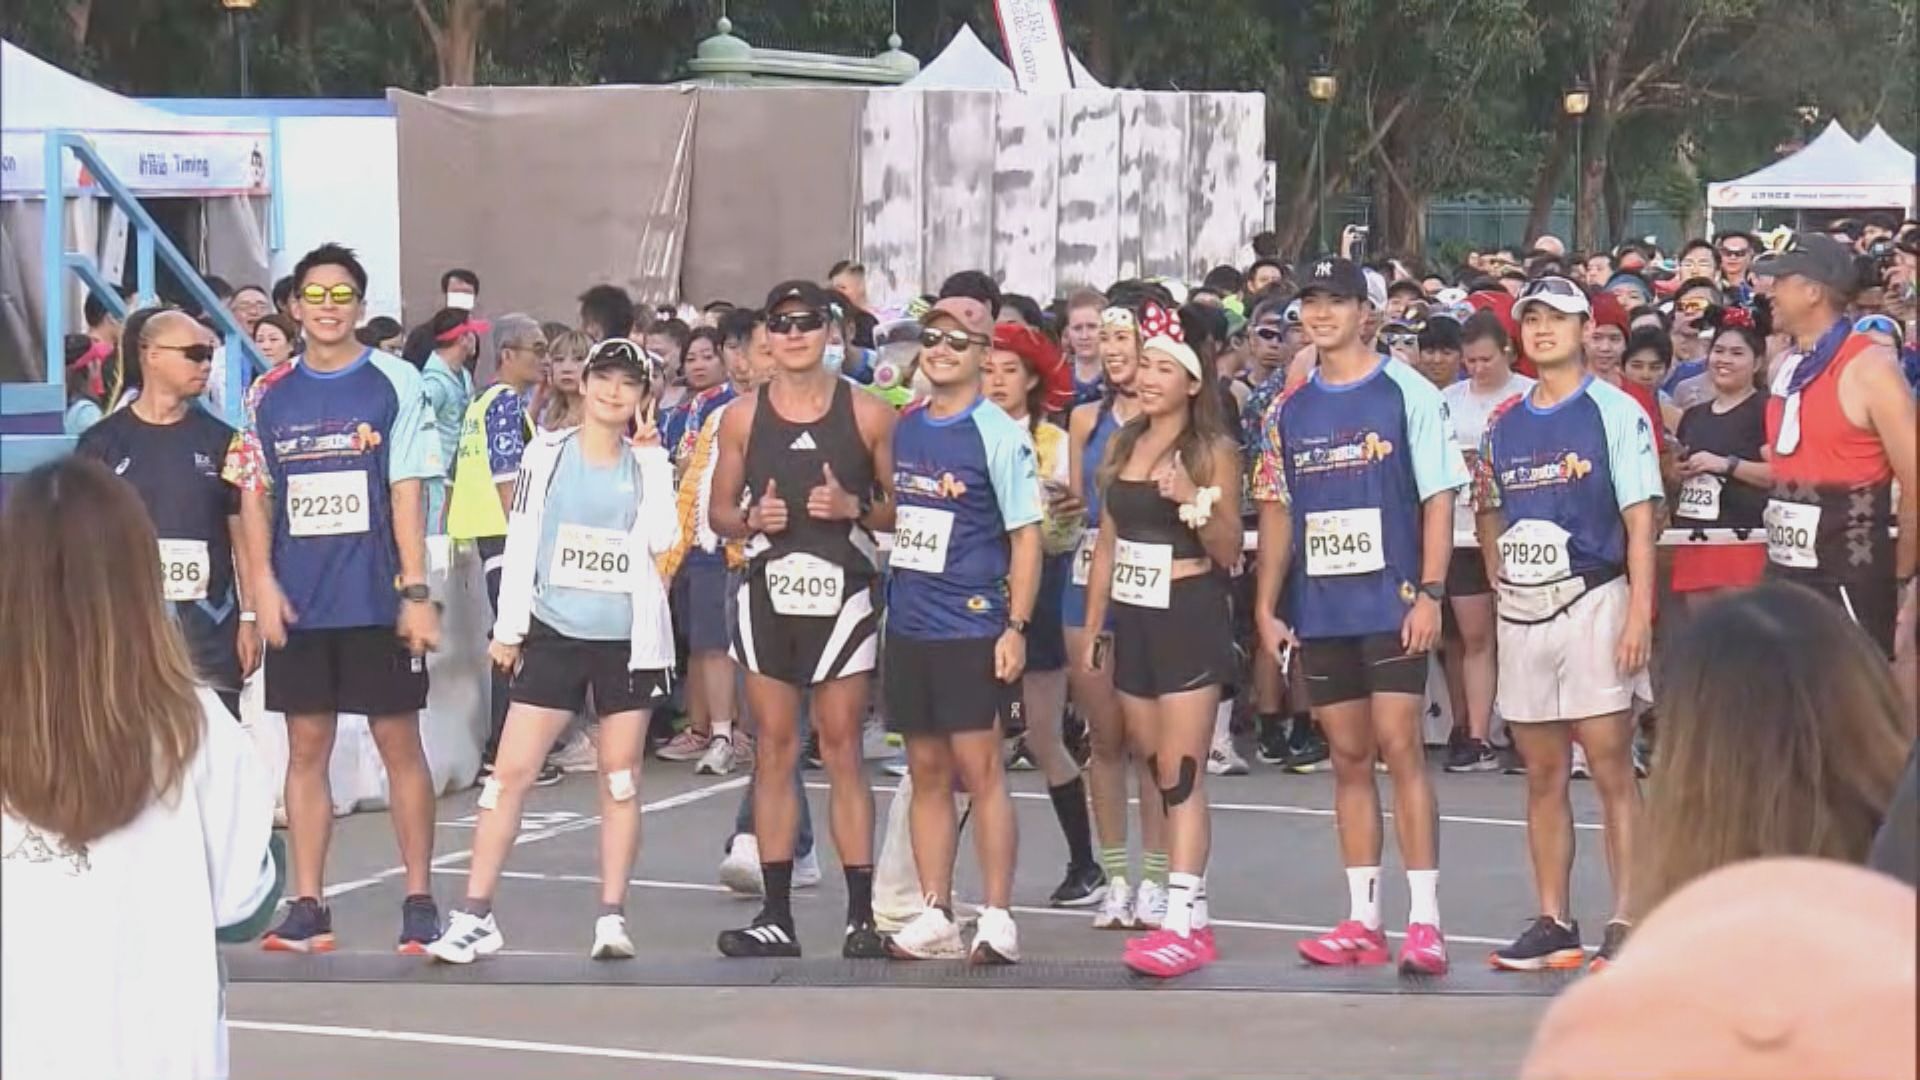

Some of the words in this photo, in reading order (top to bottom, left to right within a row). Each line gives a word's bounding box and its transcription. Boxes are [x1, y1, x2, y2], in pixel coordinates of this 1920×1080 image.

[291, 494, 360, 518] P2230
[1309, 532, 1372, 557] P1346
[1502, 542, 1558, 565] P1920
[561, 548, 630, 573] P1260
[768, 574, 837, 597] P2409
